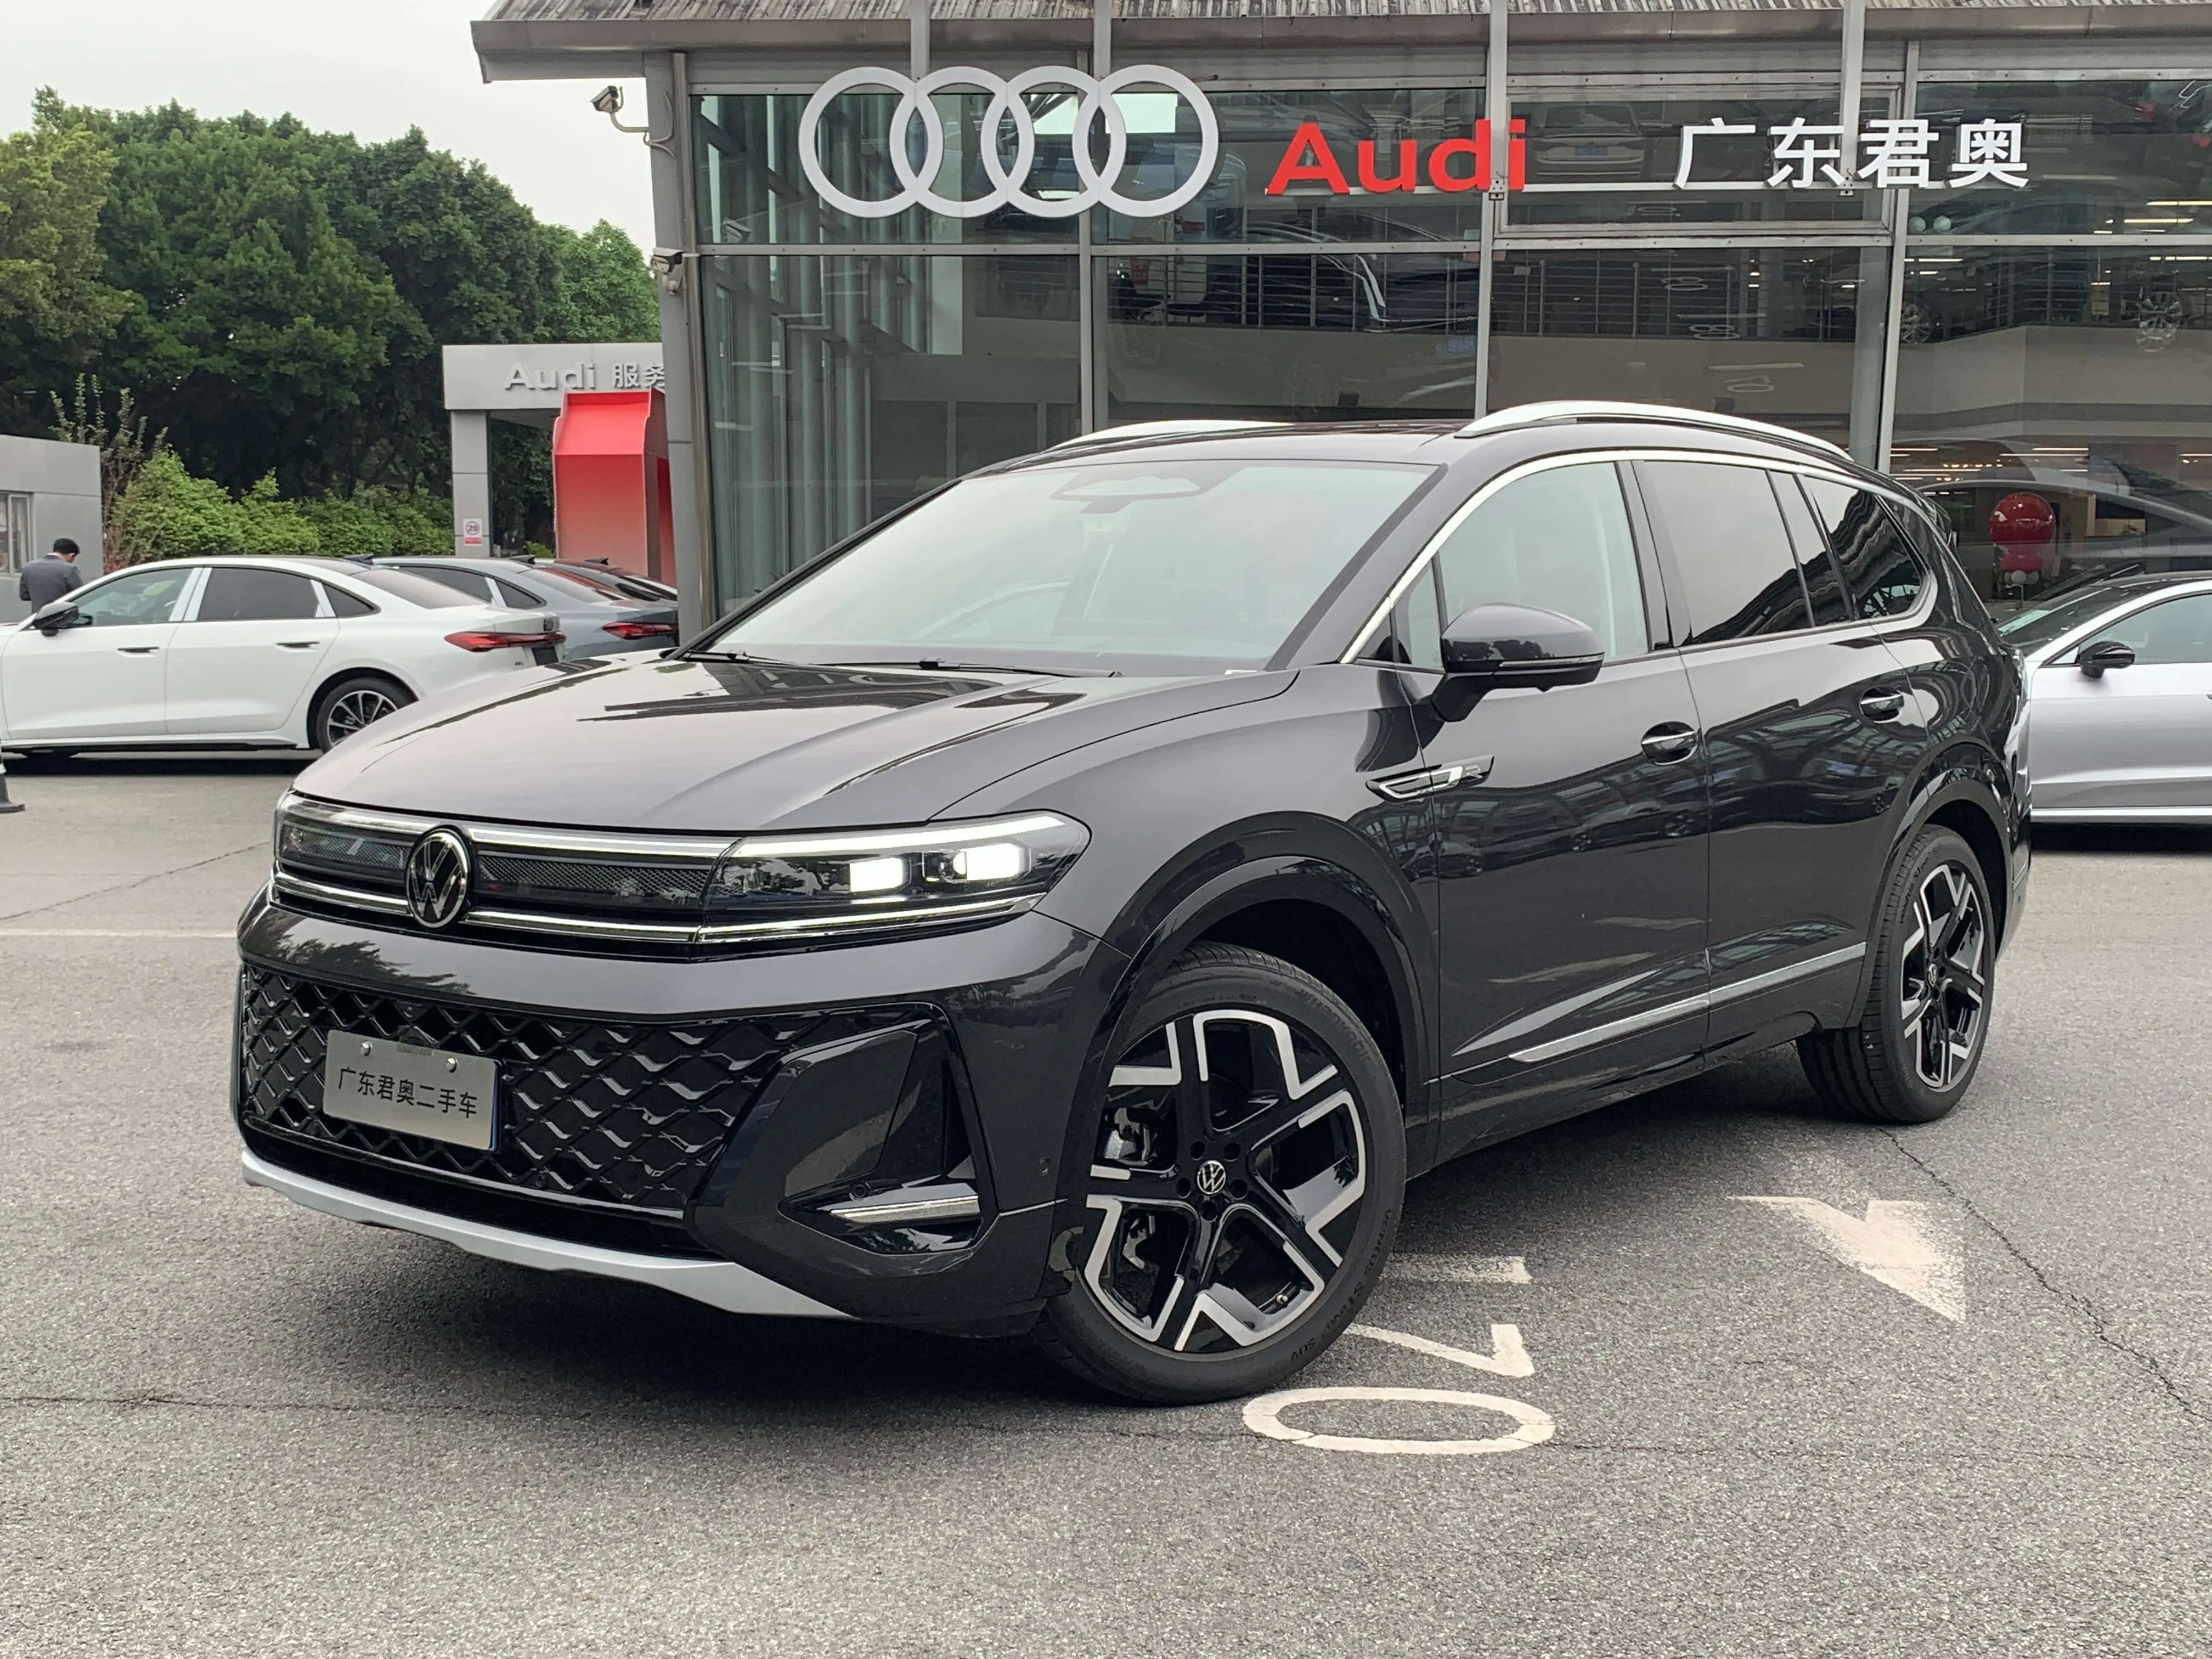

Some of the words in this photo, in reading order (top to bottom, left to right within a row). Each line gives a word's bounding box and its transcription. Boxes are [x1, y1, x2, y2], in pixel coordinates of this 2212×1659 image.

[1266, 119, 1526, 195] Audi
[1673, 117, 2030, 189] 广东君奥
[504, 362, 596, 391] Audi
[406, 828, 469, 928] VW
[338, 1066, 477, 1119] 广东君奥二手车
[1197, 1160, 1226, 1195] VW
